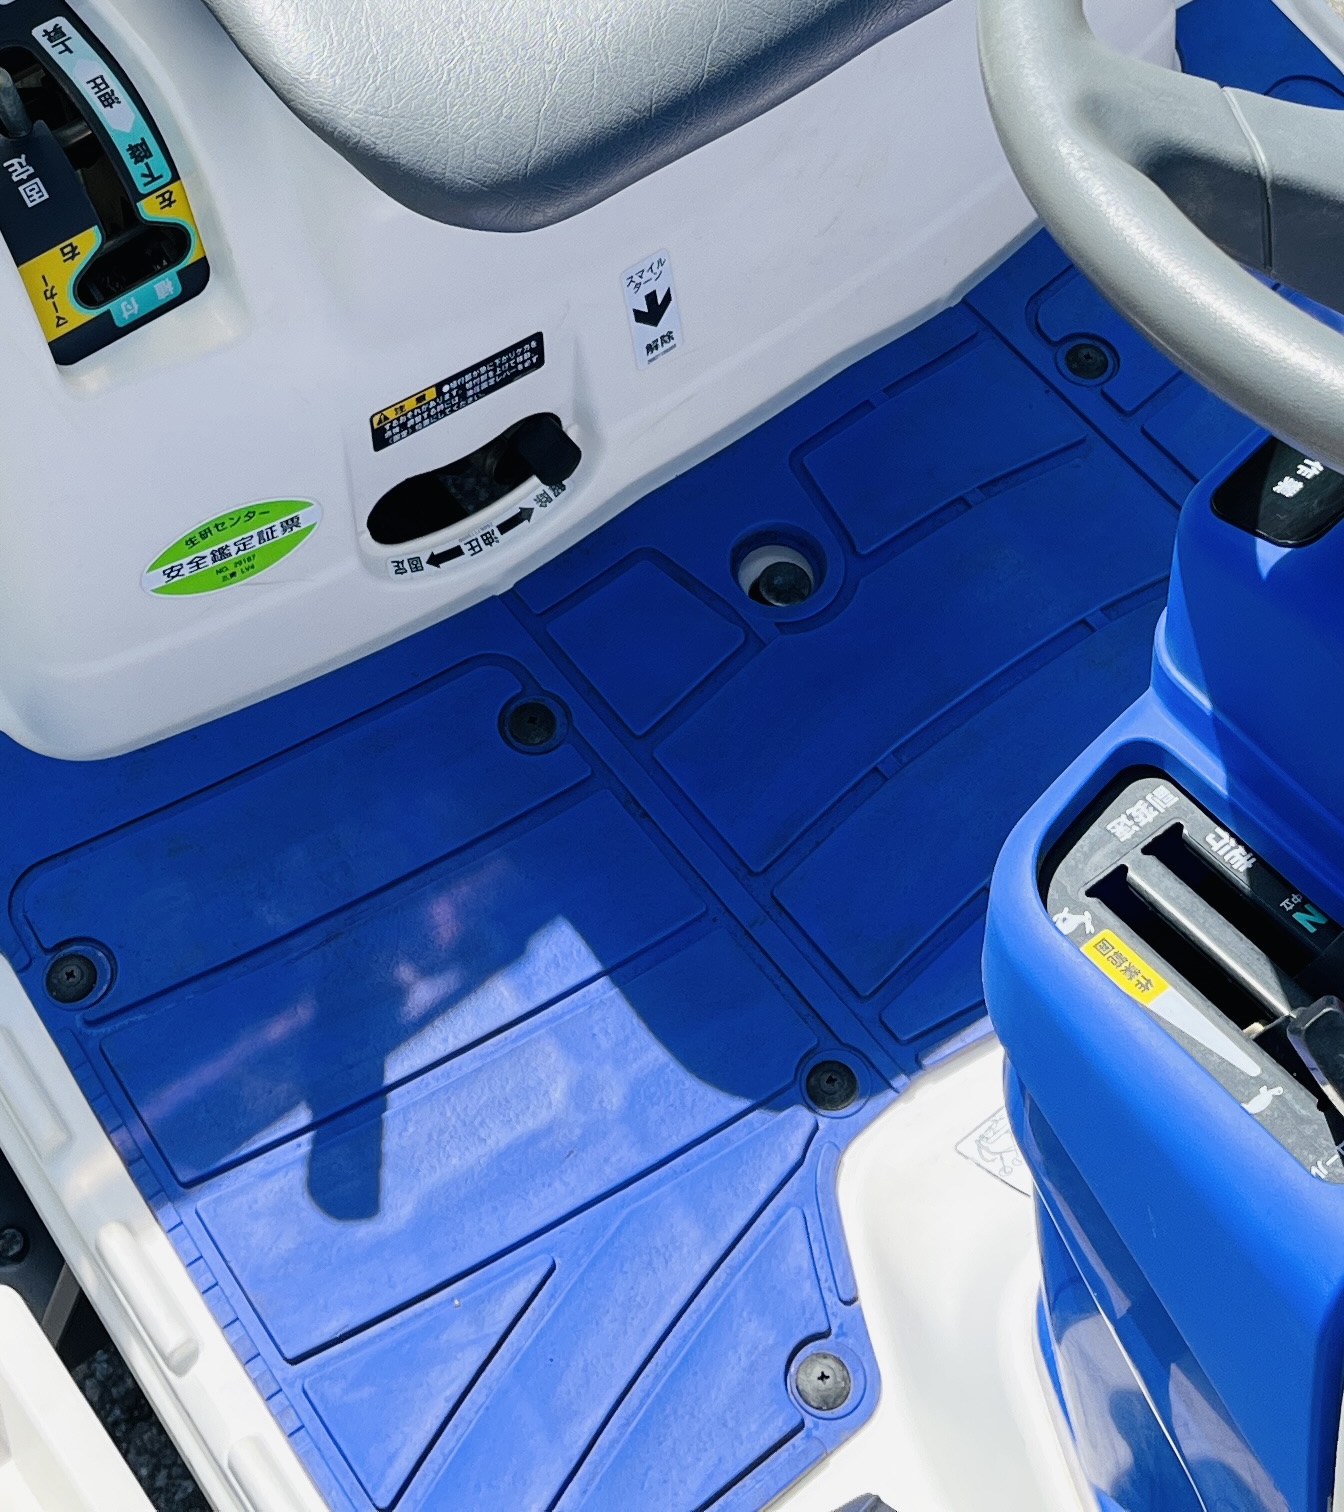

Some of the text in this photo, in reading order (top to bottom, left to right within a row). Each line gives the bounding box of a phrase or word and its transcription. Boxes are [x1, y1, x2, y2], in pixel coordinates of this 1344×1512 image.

[41, 22, 74, 57] 上昇
[86, 74, 122, 111] 油圧
[125, 136, 164, 188] 下降
[2, 153, 50, 209] 固定
[155, 189, 177, 210] 左
[59, 240, 81, 264] 右
[626, 256, 667, 289] スマイル
[633, 270, 665, 294] ターン
[40, 273, 69, 329] マーカー
[120, 277, 177, 321] 植付
[644, 329, 676, 358] 解除
[1272, 458, 1324, 498] 作業
[184, 507, 272, 550] 生研センター
[467, 527, 501, 557] 油圧
[161, 513, 304, 584] 安全鑑定証票
[392, 556, 425, 577] 固定
[1105, 785, 1180, 843] 副変速
[1204, 826, 1258, 873] 走行
[1280, 893, 1303, 912] 中立
[1291, 903, 1329, 934] N
[1092, 937, 1155, 994] 作業範囲
